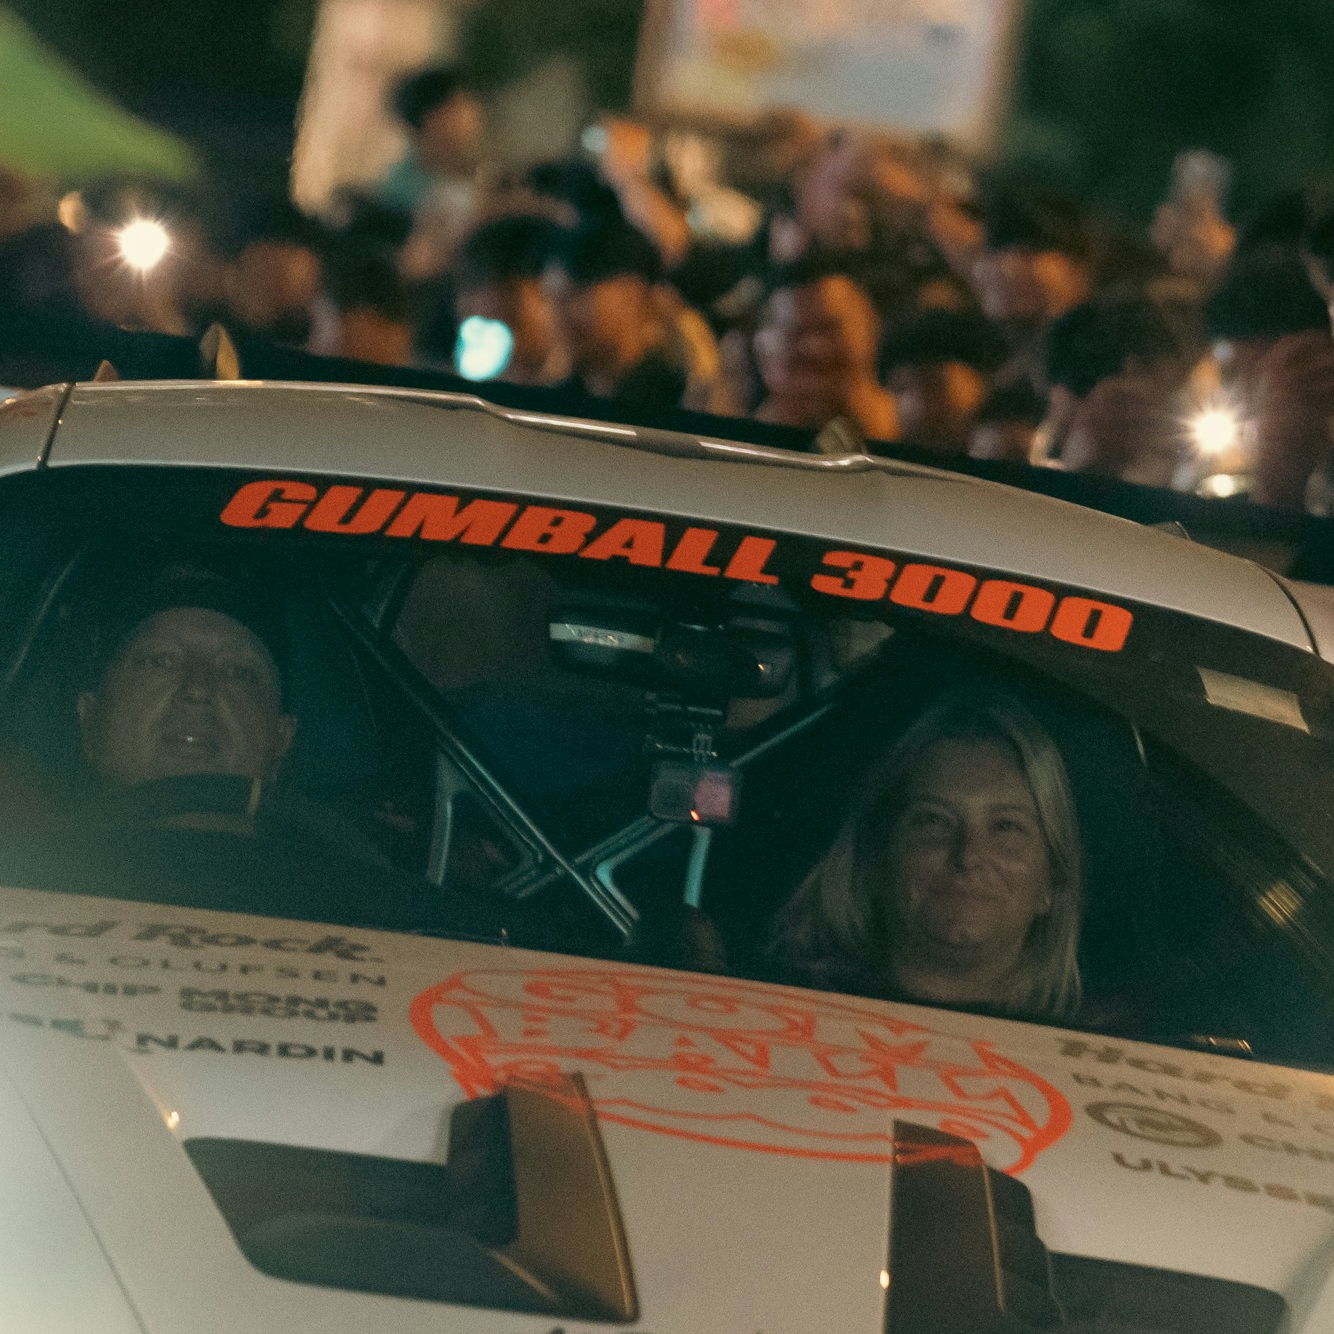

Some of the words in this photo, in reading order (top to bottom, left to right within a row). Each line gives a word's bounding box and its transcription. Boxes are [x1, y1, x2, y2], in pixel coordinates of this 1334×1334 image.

[220, 480, 779, 586] GUMBALL
[810, 550, 1135, 653] 3000
[109, 953, 388, 988] OLUFSEN
[135, 1032, 385, 1067] NARDIN
